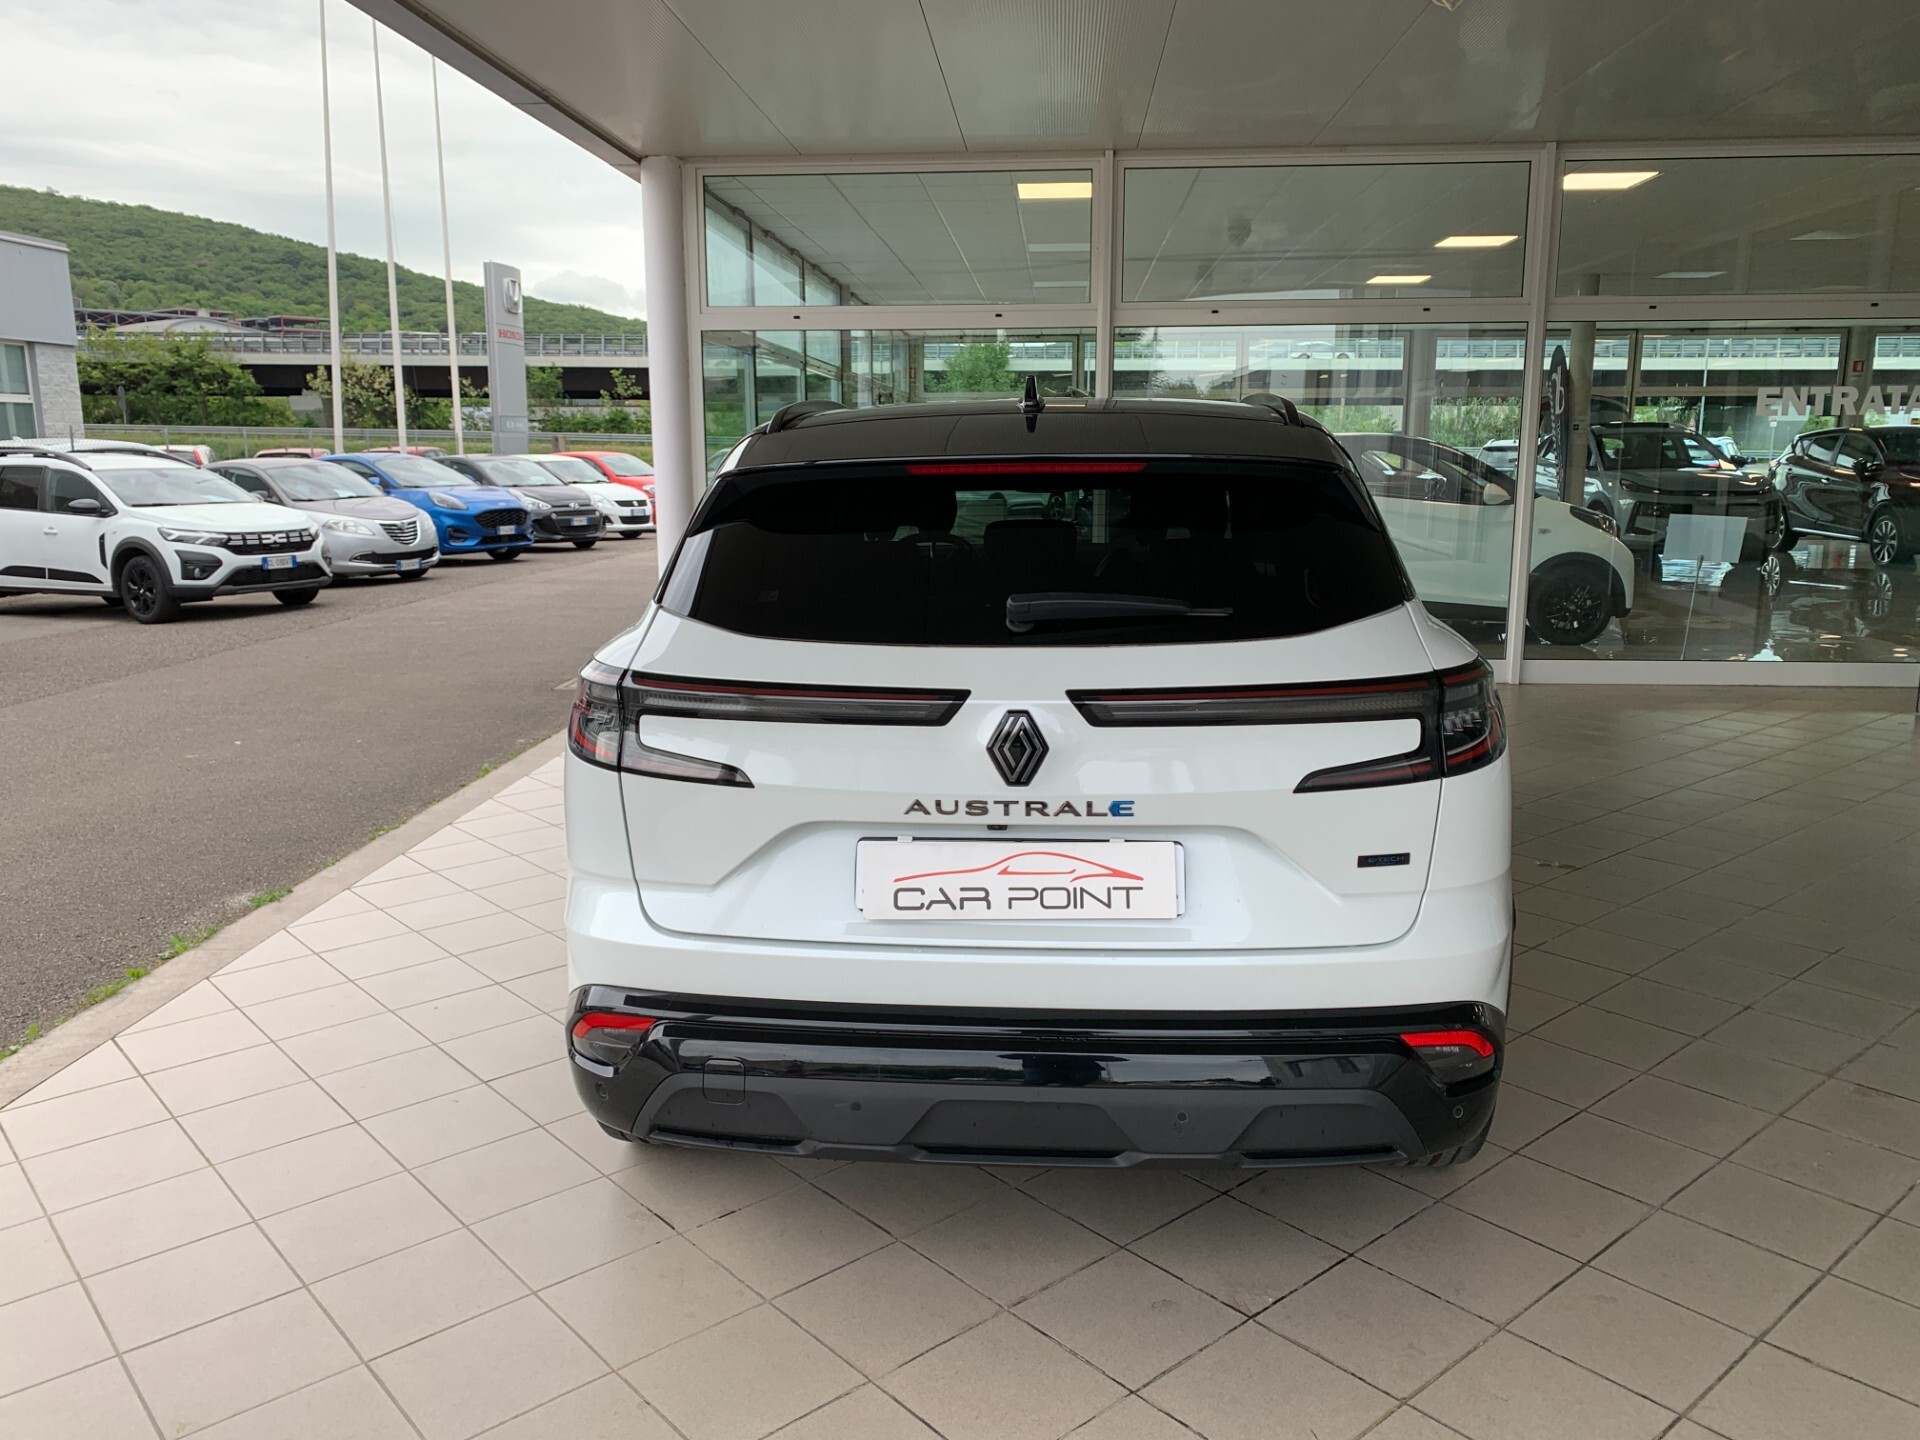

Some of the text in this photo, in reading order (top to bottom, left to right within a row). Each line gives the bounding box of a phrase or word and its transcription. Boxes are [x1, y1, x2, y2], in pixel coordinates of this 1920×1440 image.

[1756, 385, 1920, 417] ENTRATA
[903, 798, 1136, 818] AUSTRALE
[893, 885, 1144, 912] CAR POINT
